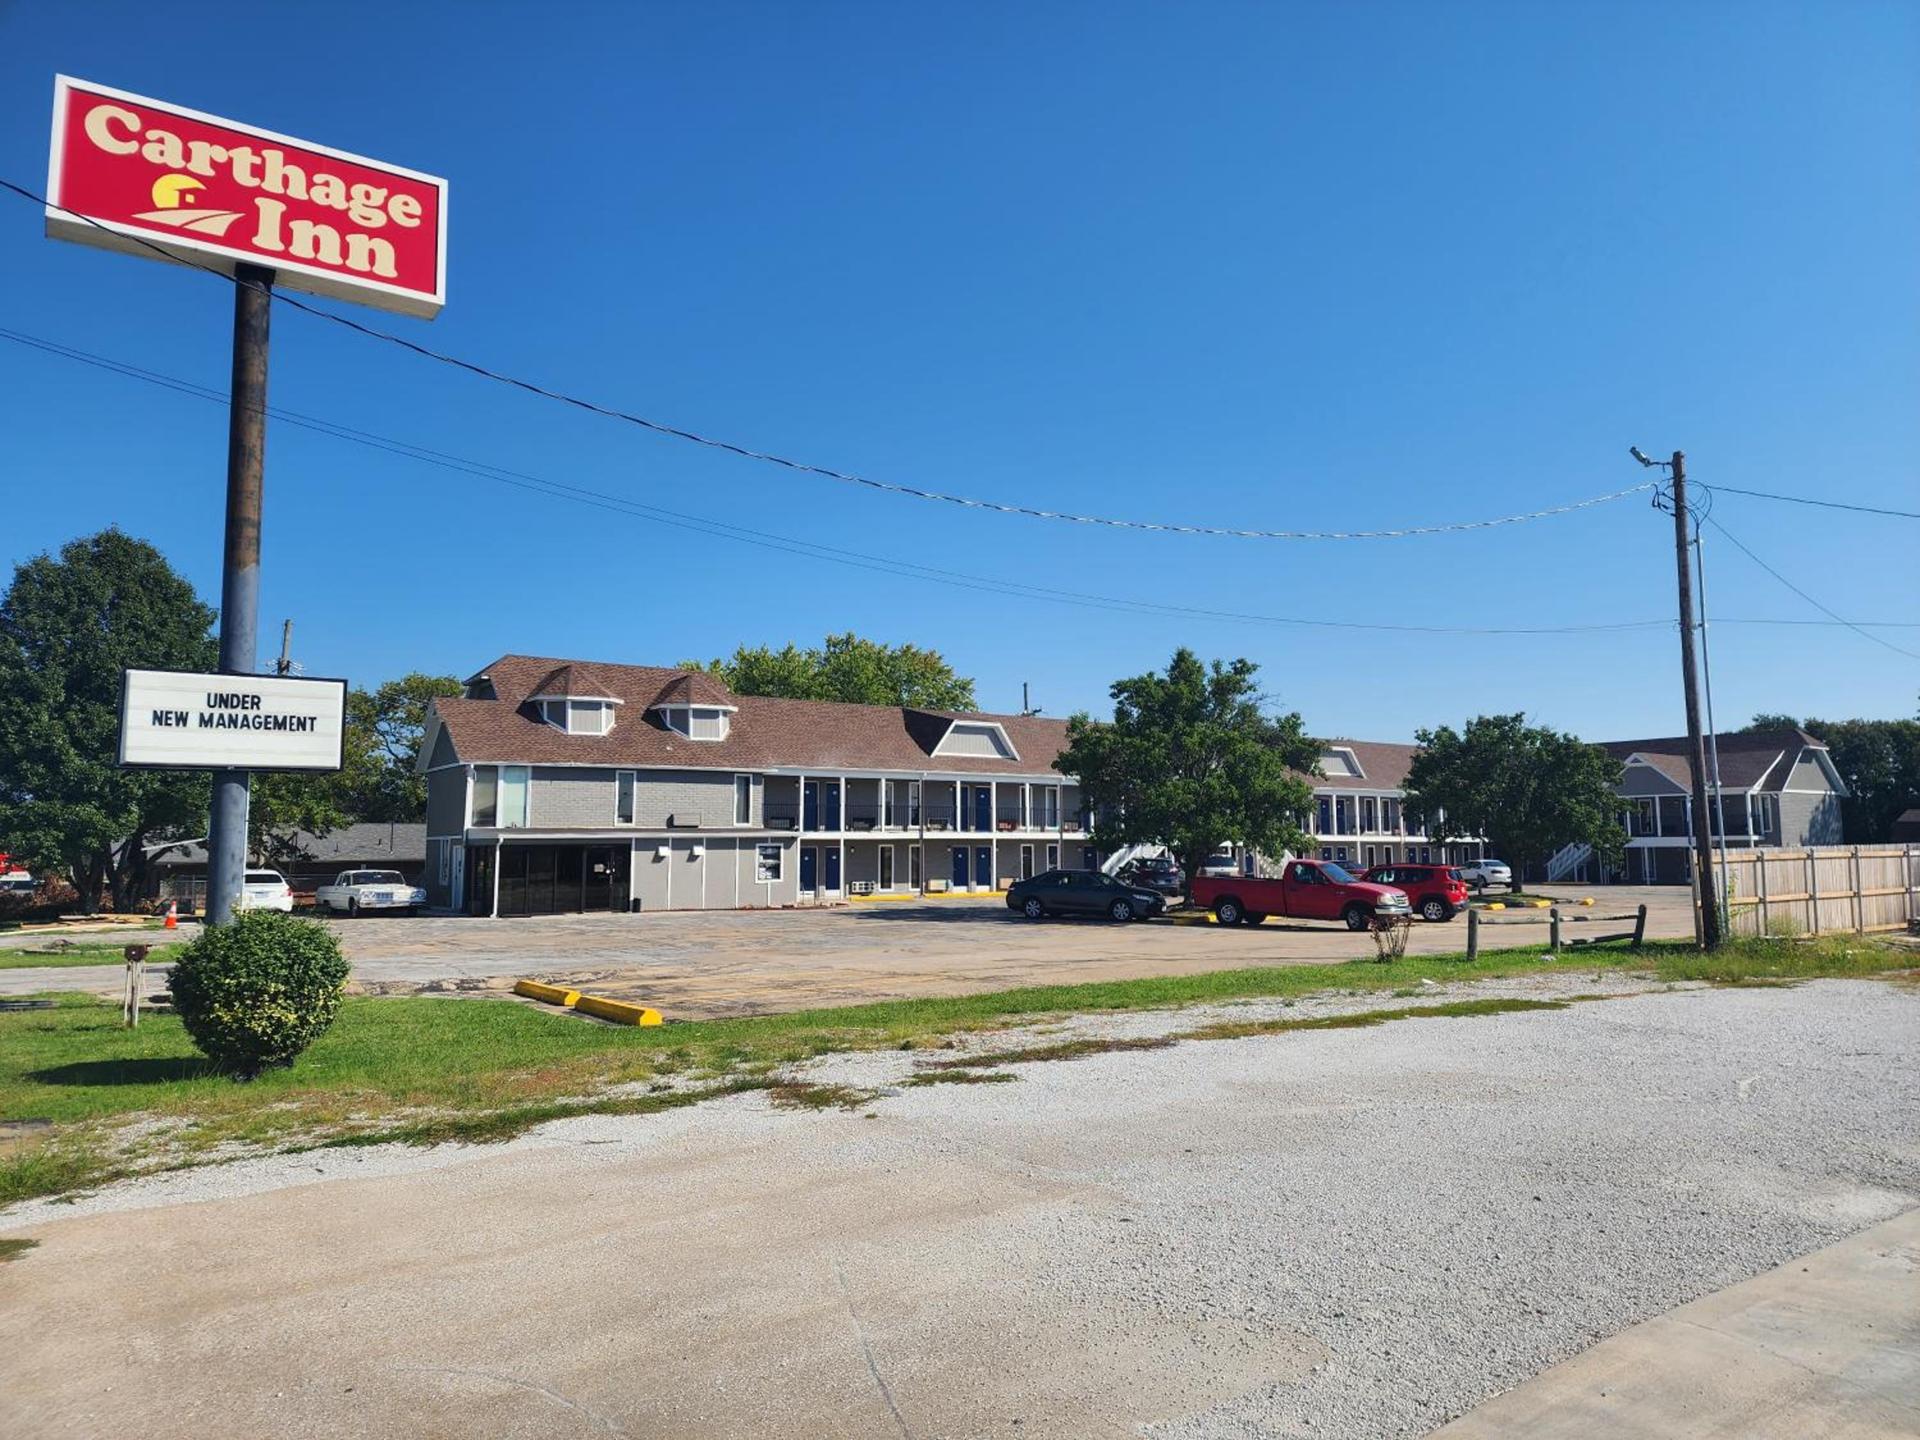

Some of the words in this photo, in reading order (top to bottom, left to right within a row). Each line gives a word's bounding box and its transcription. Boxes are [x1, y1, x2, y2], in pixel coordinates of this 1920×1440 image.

[84, 104, 422, 228] Carthage
[252, 196, 398, 278] Inn
[152, 709, 189, 728] NEW
[199, 712, 317, 732] MANAGEMENT
[206, 692, 262, 710] UNDER
